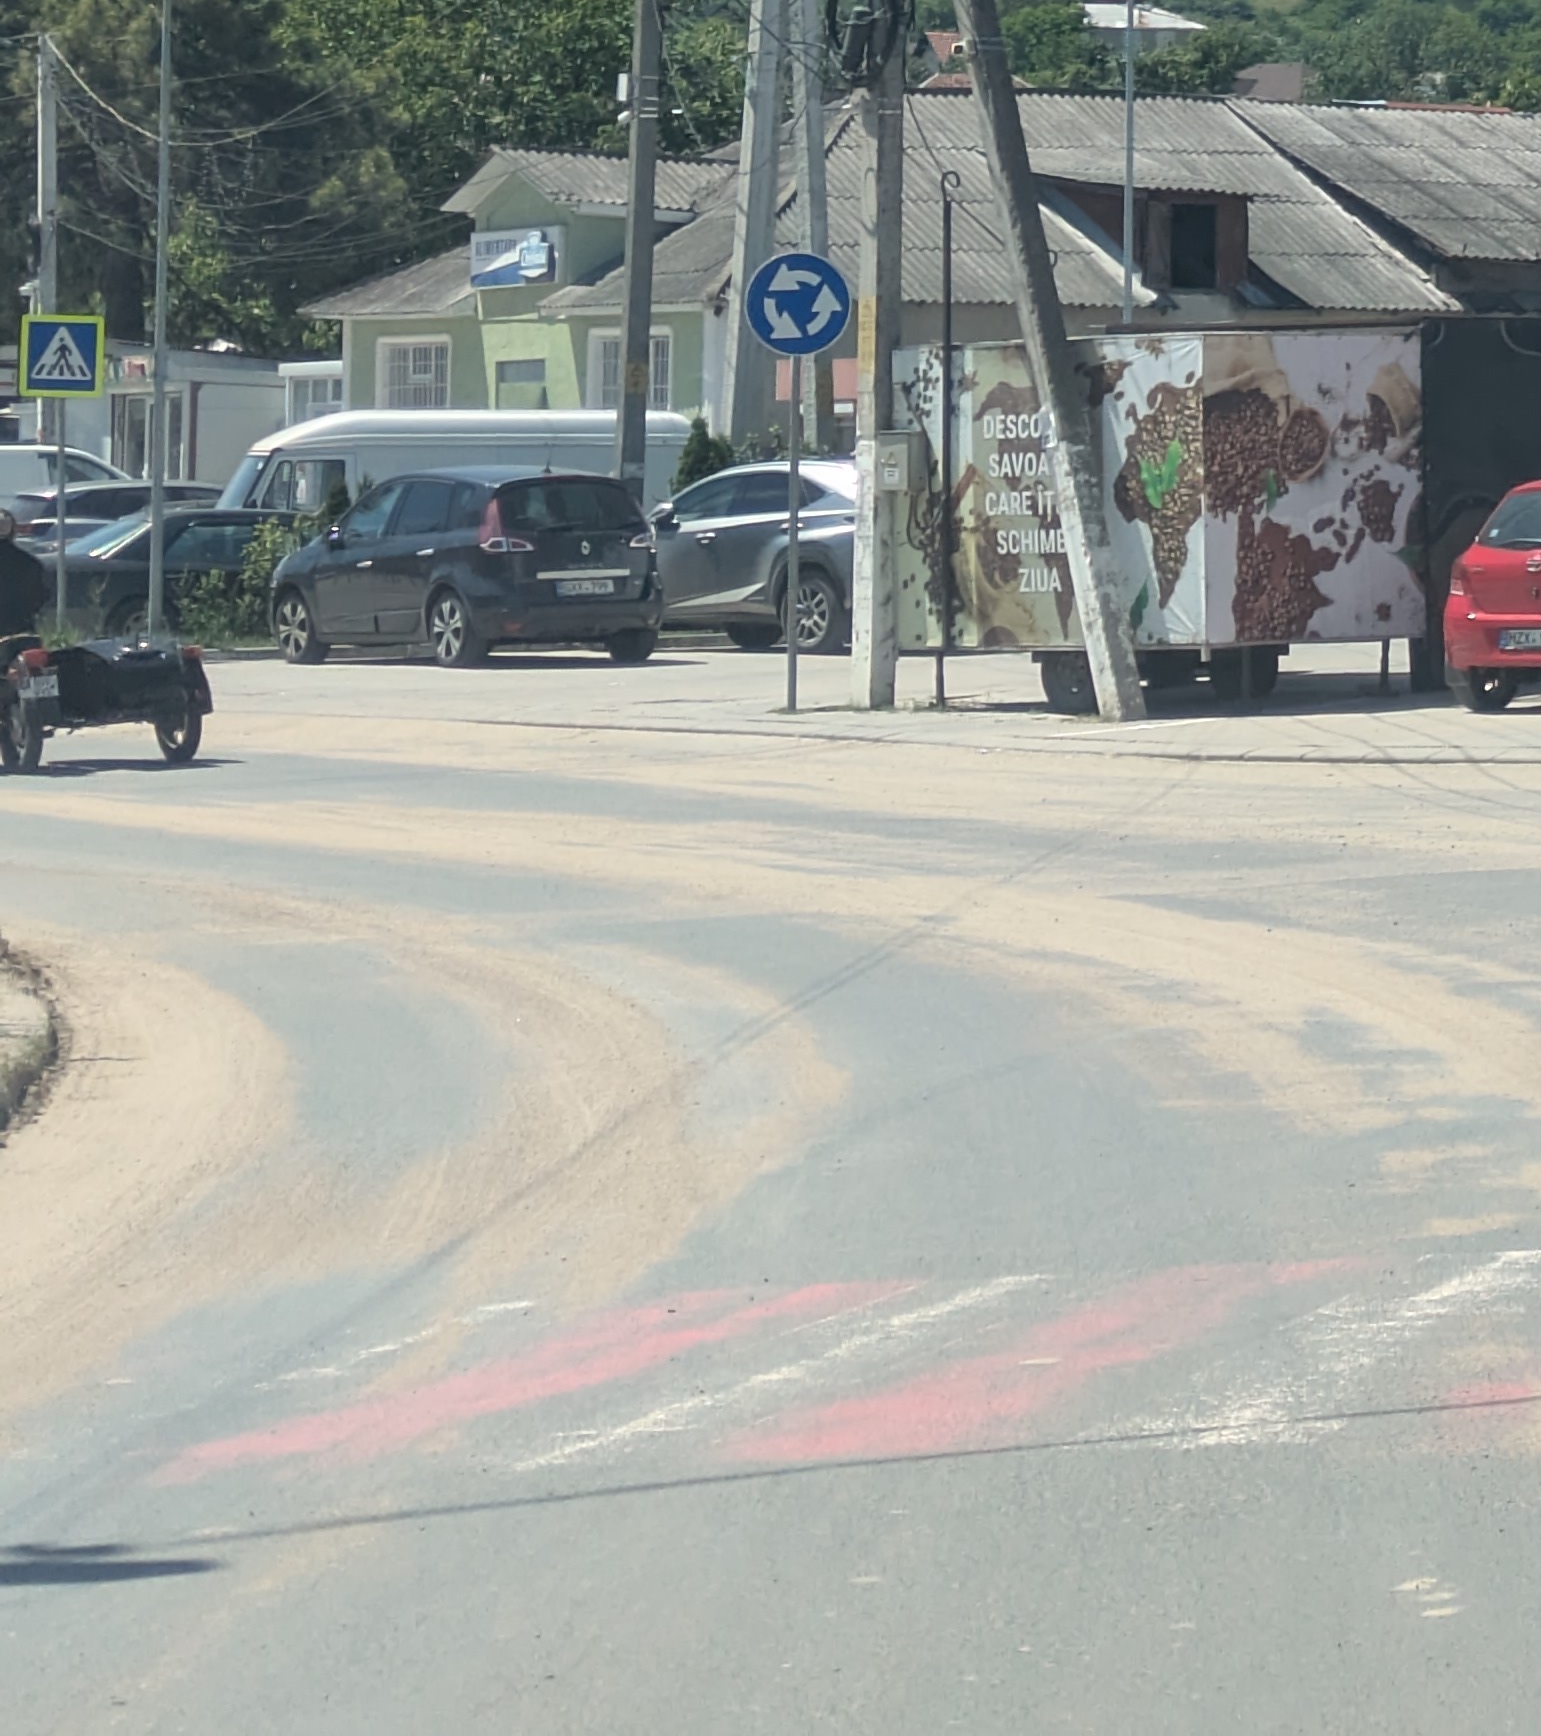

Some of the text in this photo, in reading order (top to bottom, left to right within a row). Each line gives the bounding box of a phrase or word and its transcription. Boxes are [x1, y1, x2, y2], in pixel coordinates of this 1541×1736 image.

[985, 491, 1032, 515] CARE
[997, 529, 1067, 555] SCHIMB
[1019, 567, 1063, 592] ZIUA
